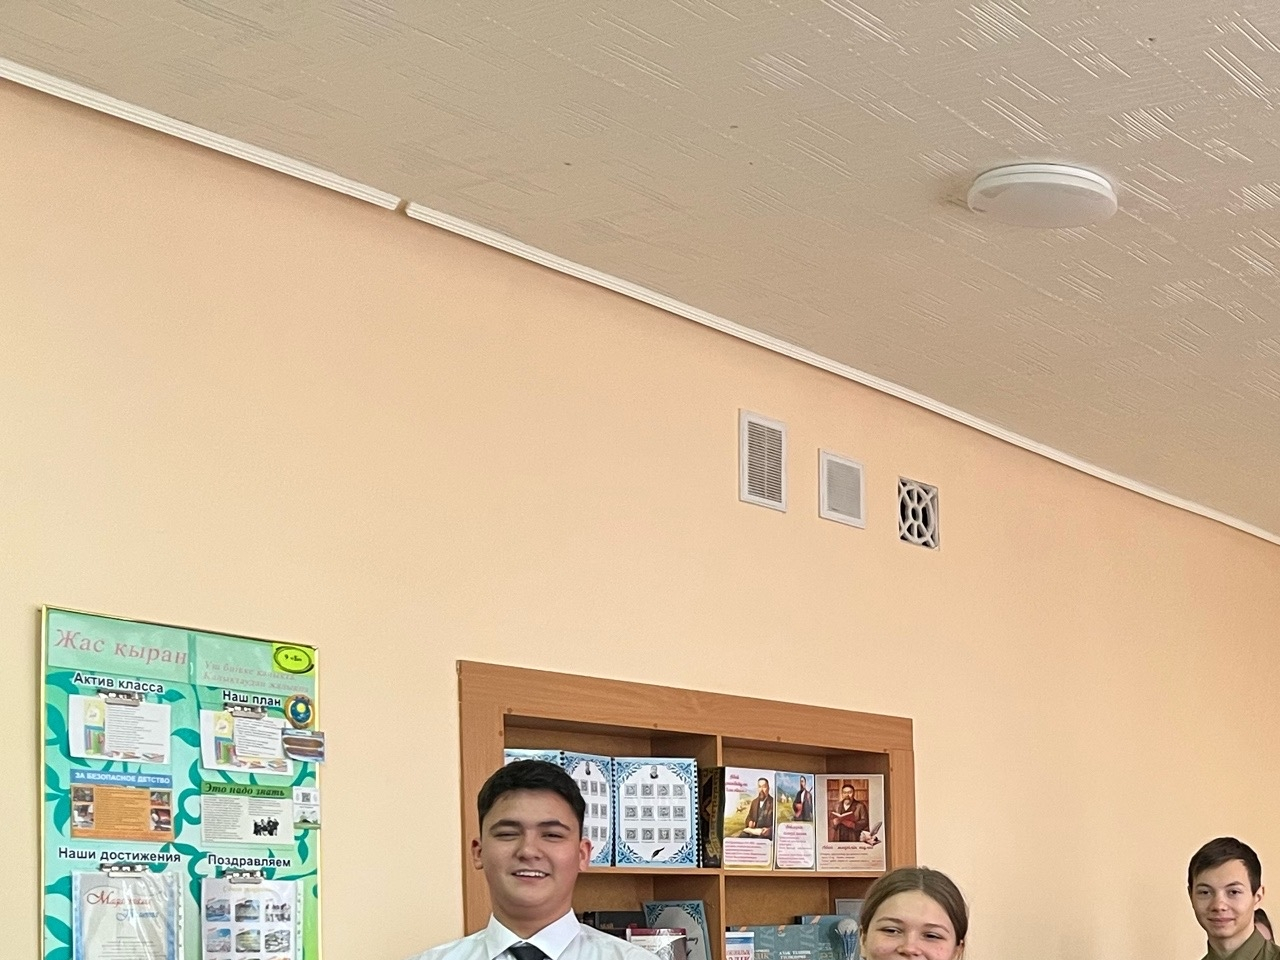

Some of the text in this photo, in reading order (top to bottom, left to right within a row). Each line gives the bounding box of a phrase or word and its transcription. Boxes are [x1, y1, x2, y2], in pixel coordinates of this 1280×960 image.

[55, 629, 105, 652] Жас
[73, 672, 164, 693] Актив класса
[223, 690, 281, 706] Наш план
[75, 772, 170, 784] ЗА БЕЗОПАСНОЕ ДЕТСТВО
[205, 782, 285, 796] Это надо знать
[58, 847, 181, 864] Наши достижения
[208, 854, 291, 868] Поздравляем
